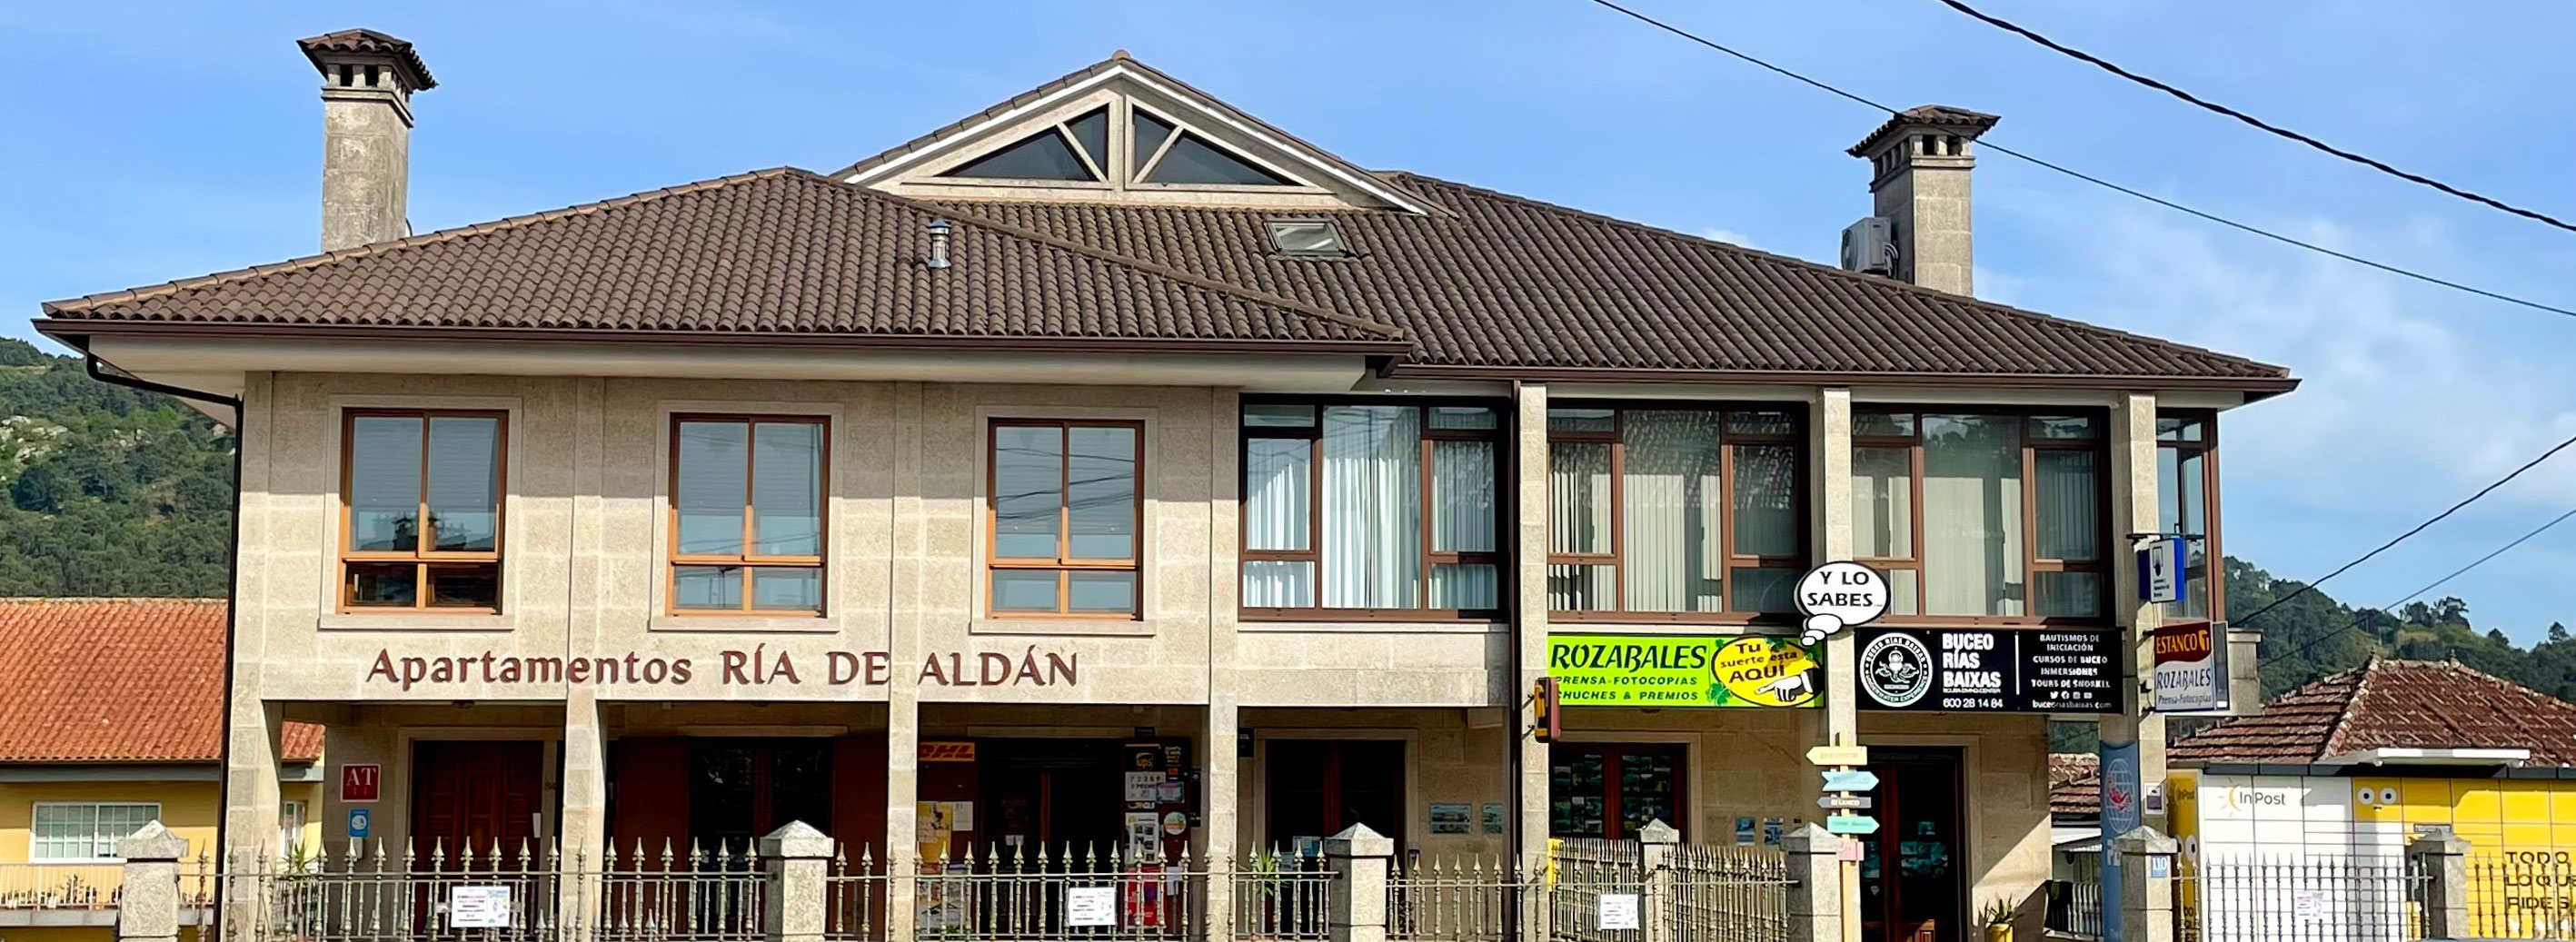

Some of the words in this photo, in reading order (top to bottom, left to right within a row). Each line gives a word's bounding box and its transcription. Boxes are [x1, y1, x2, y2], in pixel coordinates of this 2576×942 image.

[1820, 571, 1832, 584] Y
[1842, 571, 1869, 585] LO
[1942, 633, 1994, 650] BUCEO
[2040, 634, 2088, 642] BAUTISMOS
[2156, 633, 2198, 654] ESTANCO
[1736, 643, 1762, 655] Tu
[2046, 642, 2094, 651] INICIACIÓN
[1550, 644, 1707, 673] ROZABALES
[1720, 655, 1765, 669] suerte
[1943, 649, 1981, 669] RÍAS
[2080, 656, 2108, 664] BUCEO
[365, 648, 693, 691] Apartamentos
[719, 642, 801, 685] RÍA
[825, 650, 891, 686] DE
[918, 644, 1079, 687] ALDÁN
[1728, 660, 1786, 683] AQUÍ
[2041, 668, 2098, 676] INMERSIONES
[1943, 671, 2002, 688] BAIXAS
[2031, 679, 2059, 688] TOURS
[2060, 679, 2071, 688] DE
[1623, 691, 1632, 700] &
[1638, 691, 1698, 700] PREMIOS
[1943, 698, 1962, 708] 600
[1963, 698, 1975, 708] 28
[1977, 699, 1990, 708] 14
[1991, 698, 2004, 709] 84
[345, 767, 377, 787] AT
[2239, 791, 2286, 806] InPost
[2152, 857, 2168, 871] 110
[2504, 850, 2570, 864] TODO
